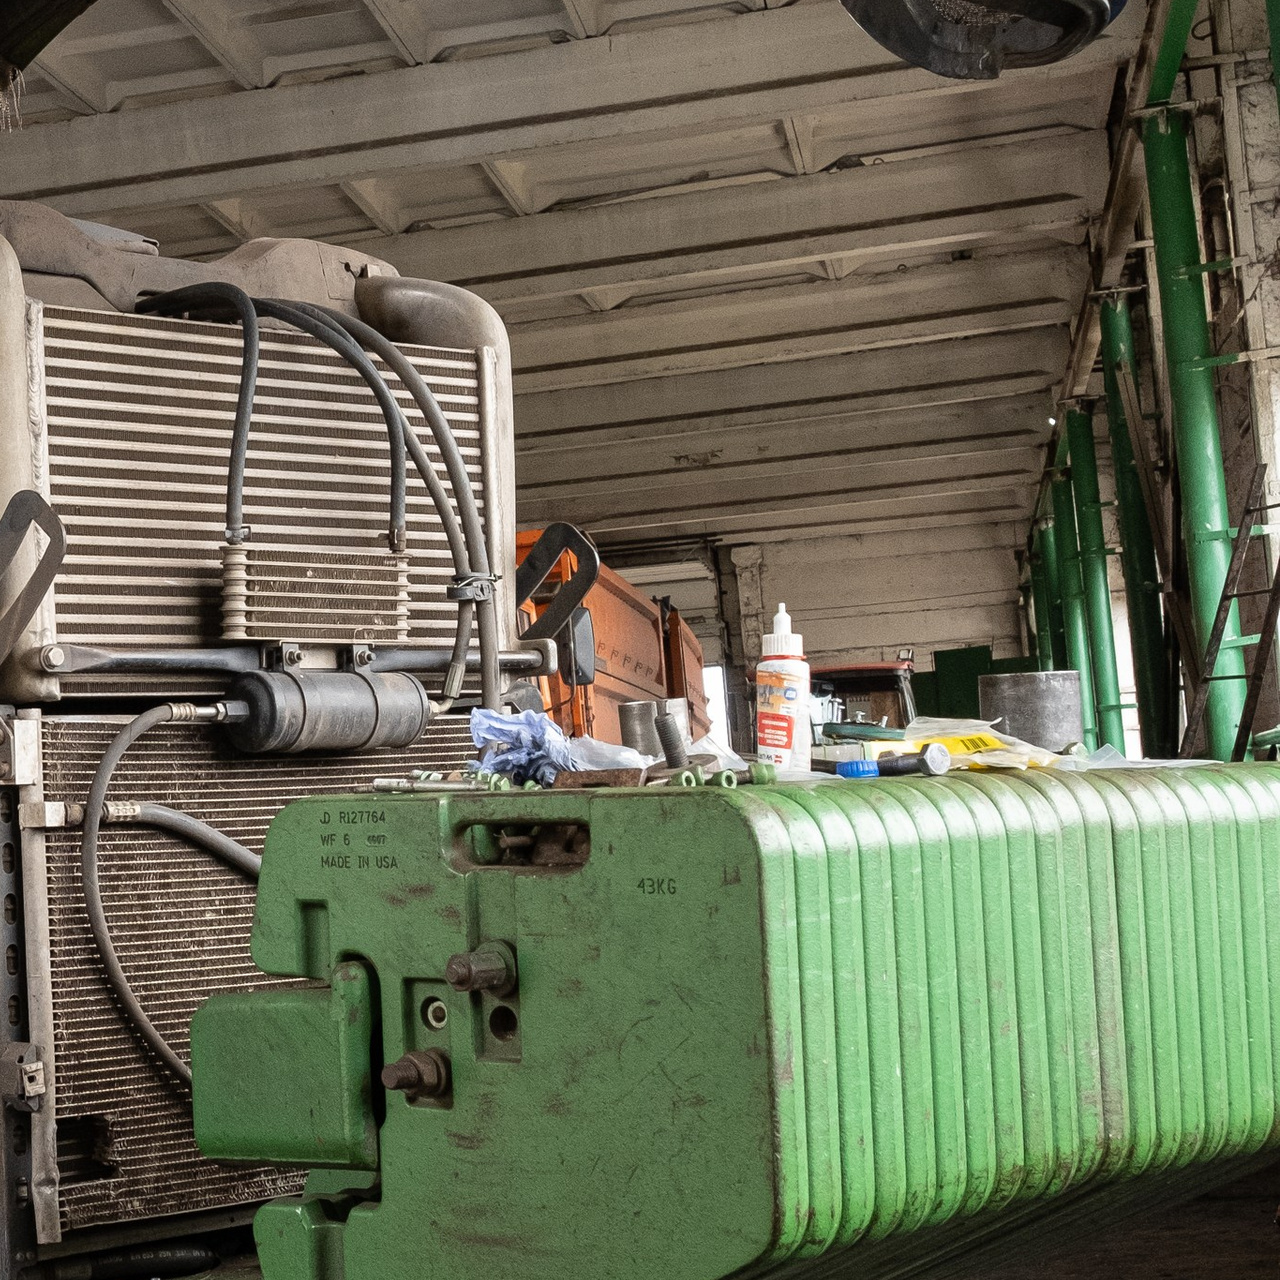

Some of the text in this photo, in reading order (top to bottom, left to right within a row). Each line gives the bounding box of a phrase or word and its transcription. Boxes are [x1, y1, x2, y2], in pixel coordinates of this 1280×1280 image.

[339, 810, 386, 824] R127764
[320, 833, 336, 846] WF
[343, 833, 351, 846] 6
[321, 855, 399, 869] MADE IN USA
[637, 877, 677, 895] 43KG
